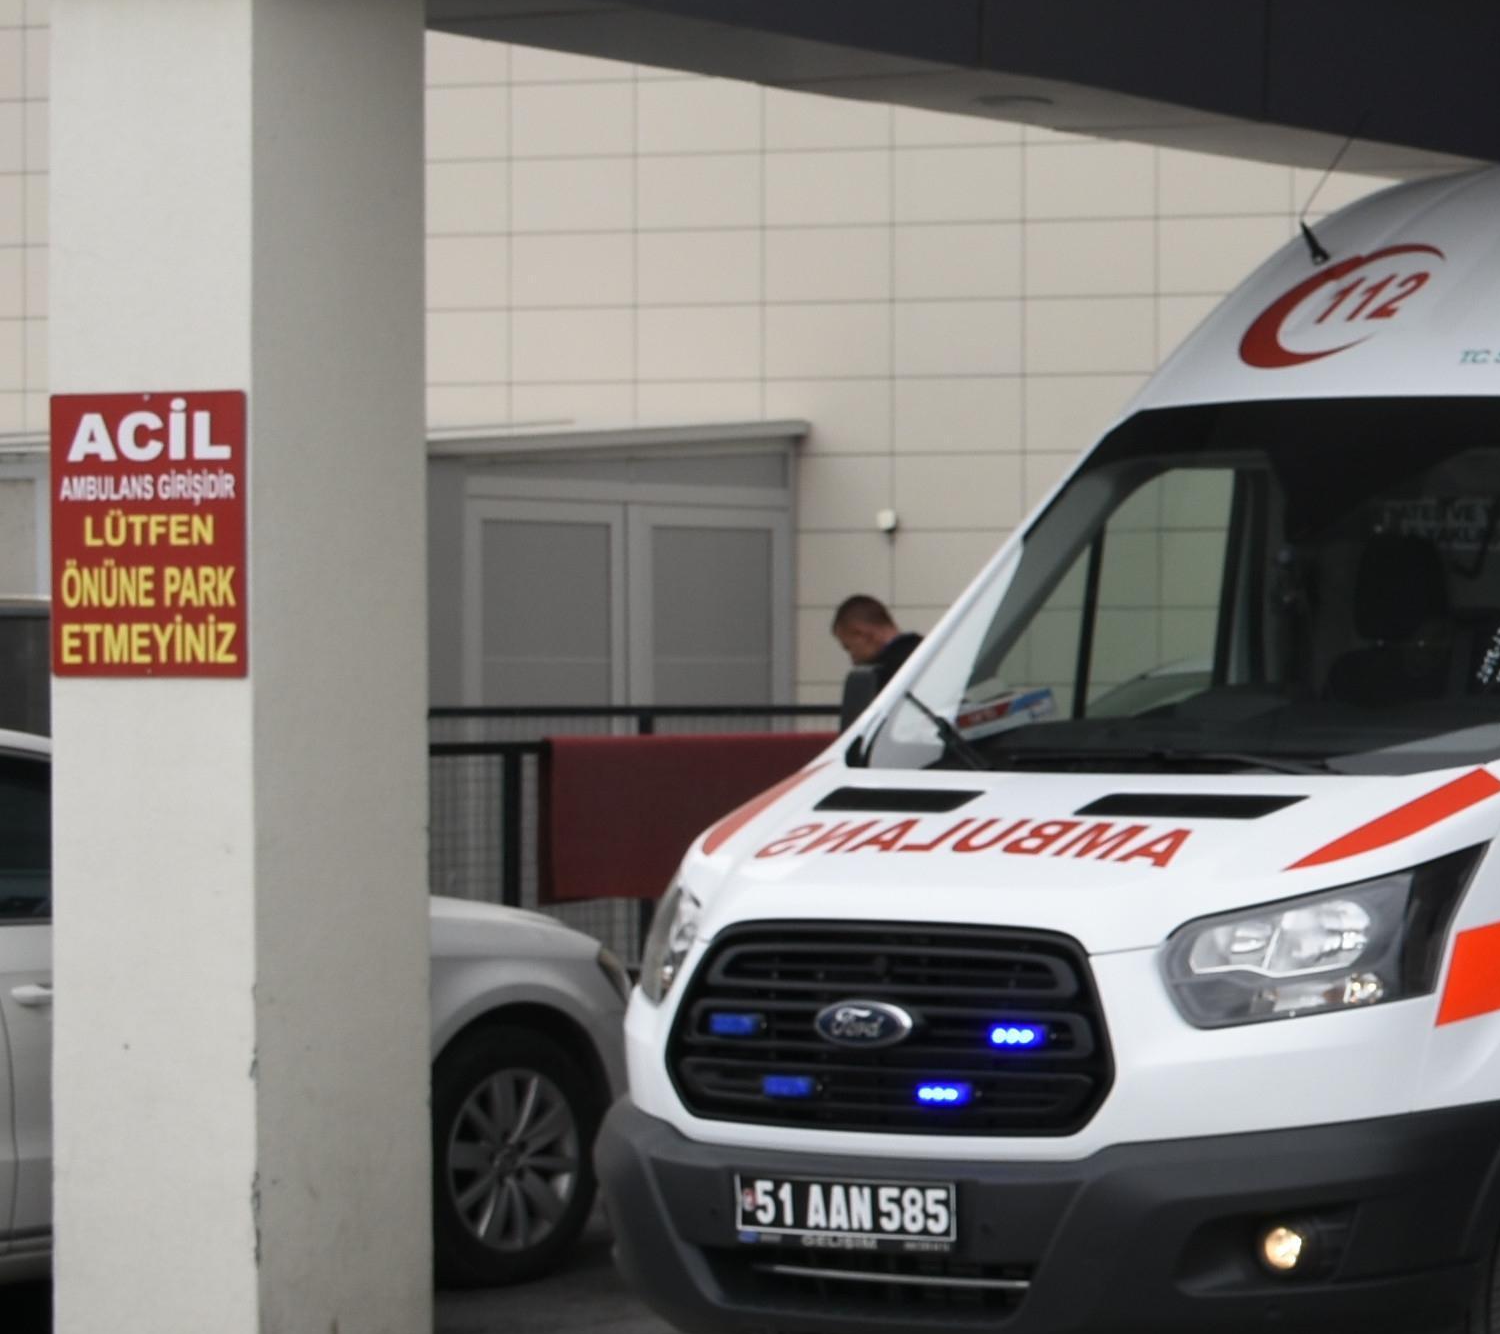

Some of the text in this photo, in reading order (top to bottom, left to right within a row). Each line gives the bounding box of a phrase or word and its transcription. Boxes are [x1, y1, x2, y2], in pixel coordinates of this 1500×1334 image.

[1314, 271, 1429, 325] 112
[67, 398, 232, 462] ACİL
[60, 469, 235, 505] AMBULANS GİRİŞİDİR
[84, 509, 213, 547] LÜTFEN
[62, 559, 236, 608] ÖNÜNE PARK
[62, 614, 237, 665] ETMEYİNİZ
[831, 1007, 885, 1037] Ford
[754, 1179, 950, 1235] 51 AAN 585
